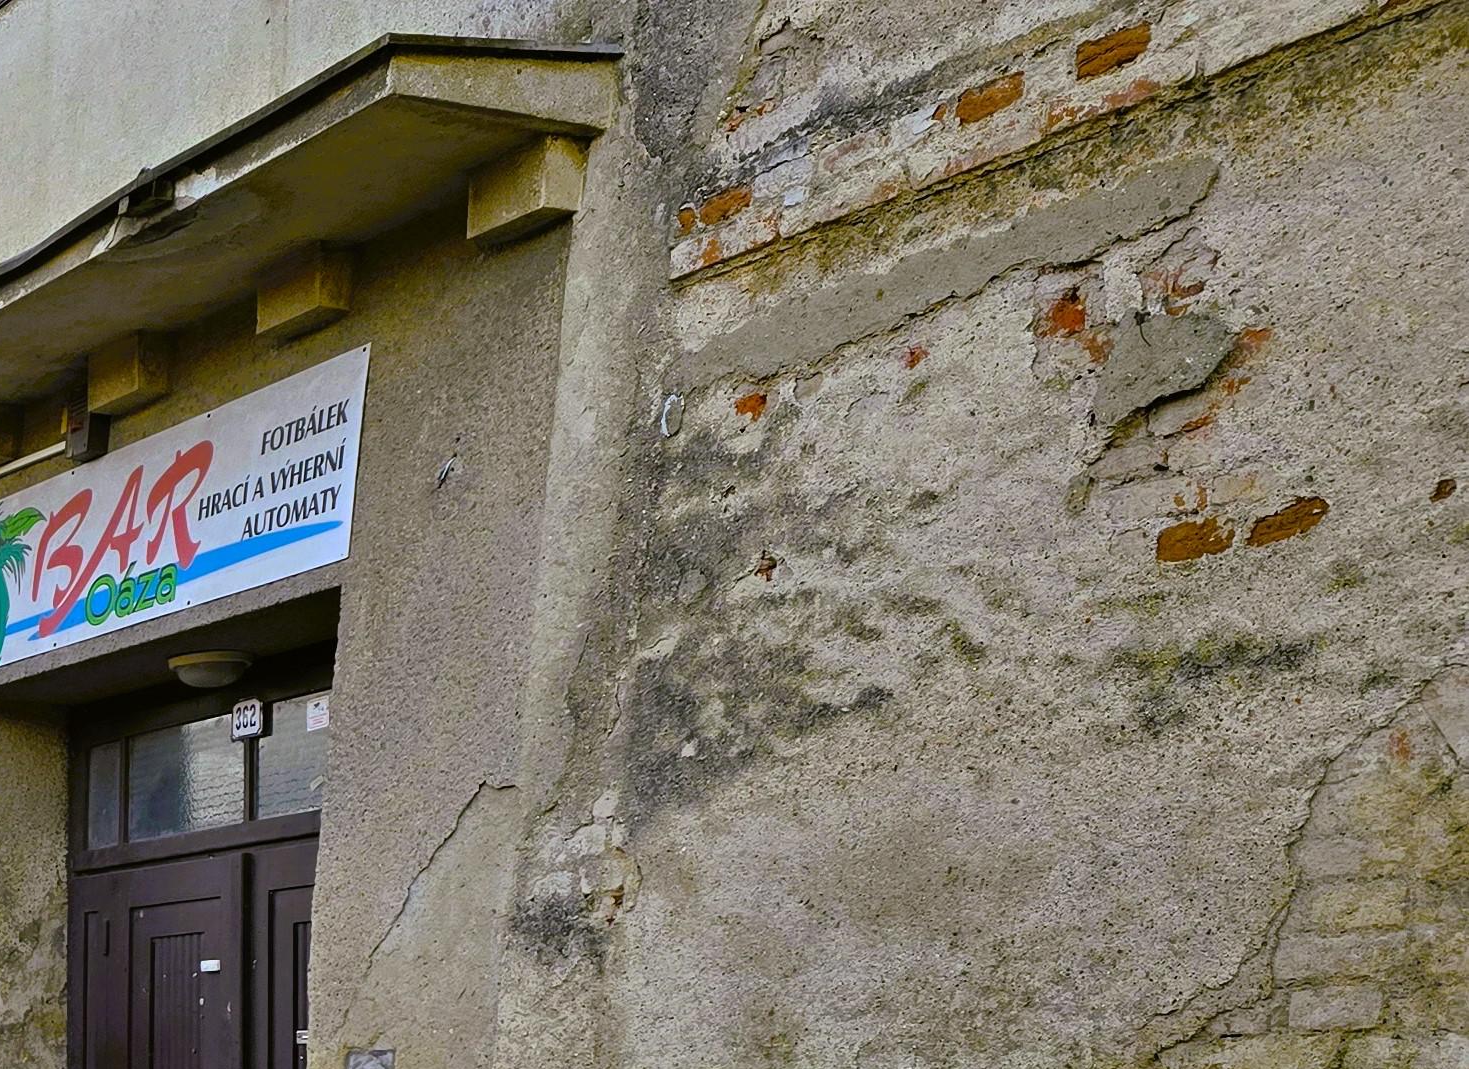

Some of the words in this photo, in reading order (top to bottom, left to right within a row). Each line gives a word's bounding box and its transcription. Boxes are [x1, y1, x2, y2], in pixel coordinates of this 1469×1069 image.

[261, 401, 350, 455] FOTBÁLEK
[197, 481, 250, 522] HRACÍ
[252, 481, 267, 503] A
[270, 438, 346, 494] VÝHERNÍ
[31, 439, 215, 639] BAR
[240, 484, 342, 542] AUTOMATY
[84, 560, 178, 627] Oáza
[235, 703, 257, 731] 362
